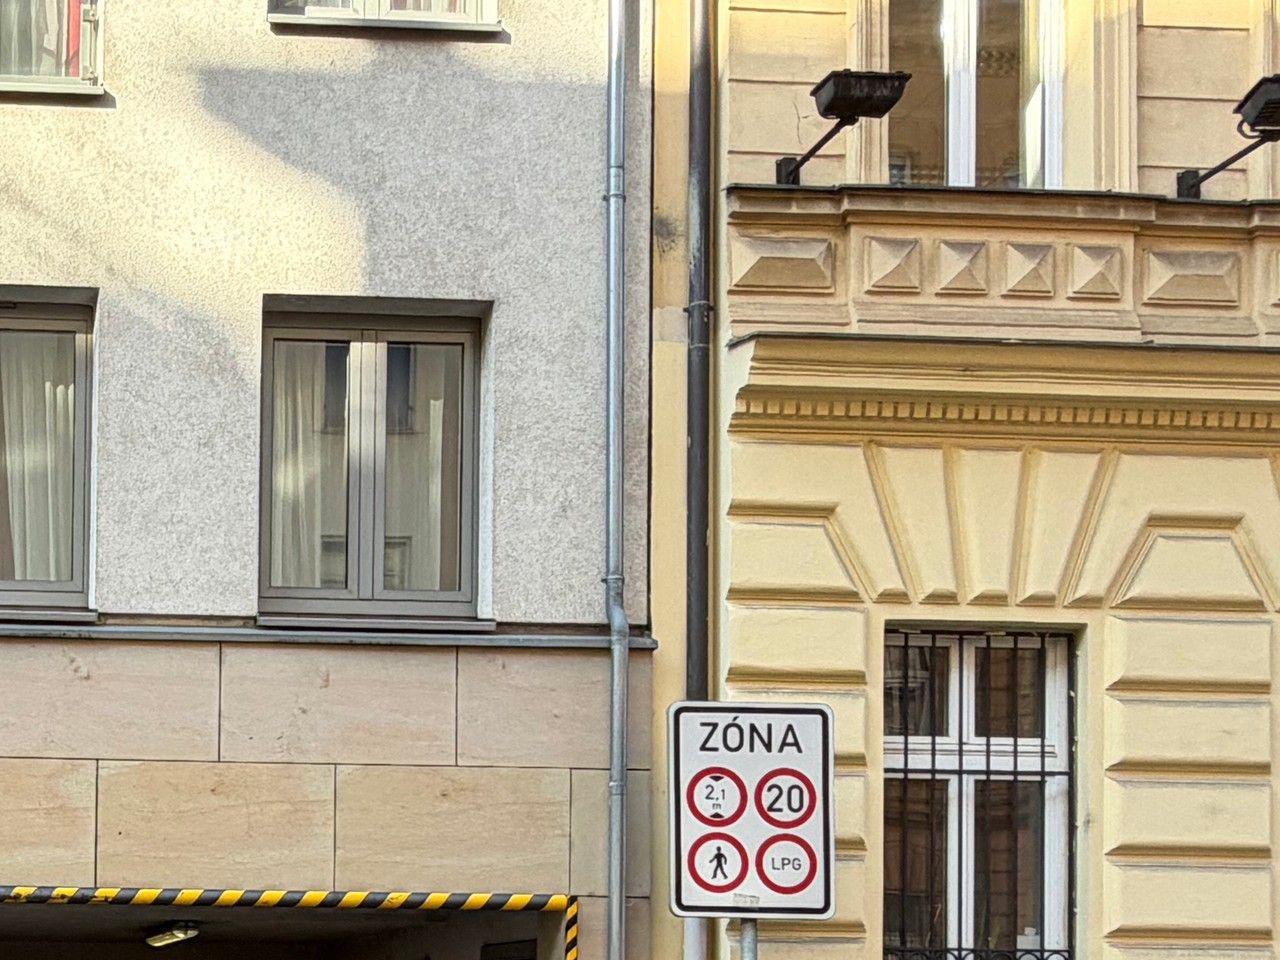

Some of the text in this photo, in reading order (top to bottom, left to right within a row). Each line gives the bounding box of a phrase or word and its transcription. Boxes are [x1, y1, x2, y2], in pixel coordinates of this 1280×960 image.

[699, 716, 803, 753] ZÓNA
[766, 784, 804, 813] 20
[771, 857, 802, 871] LPG
